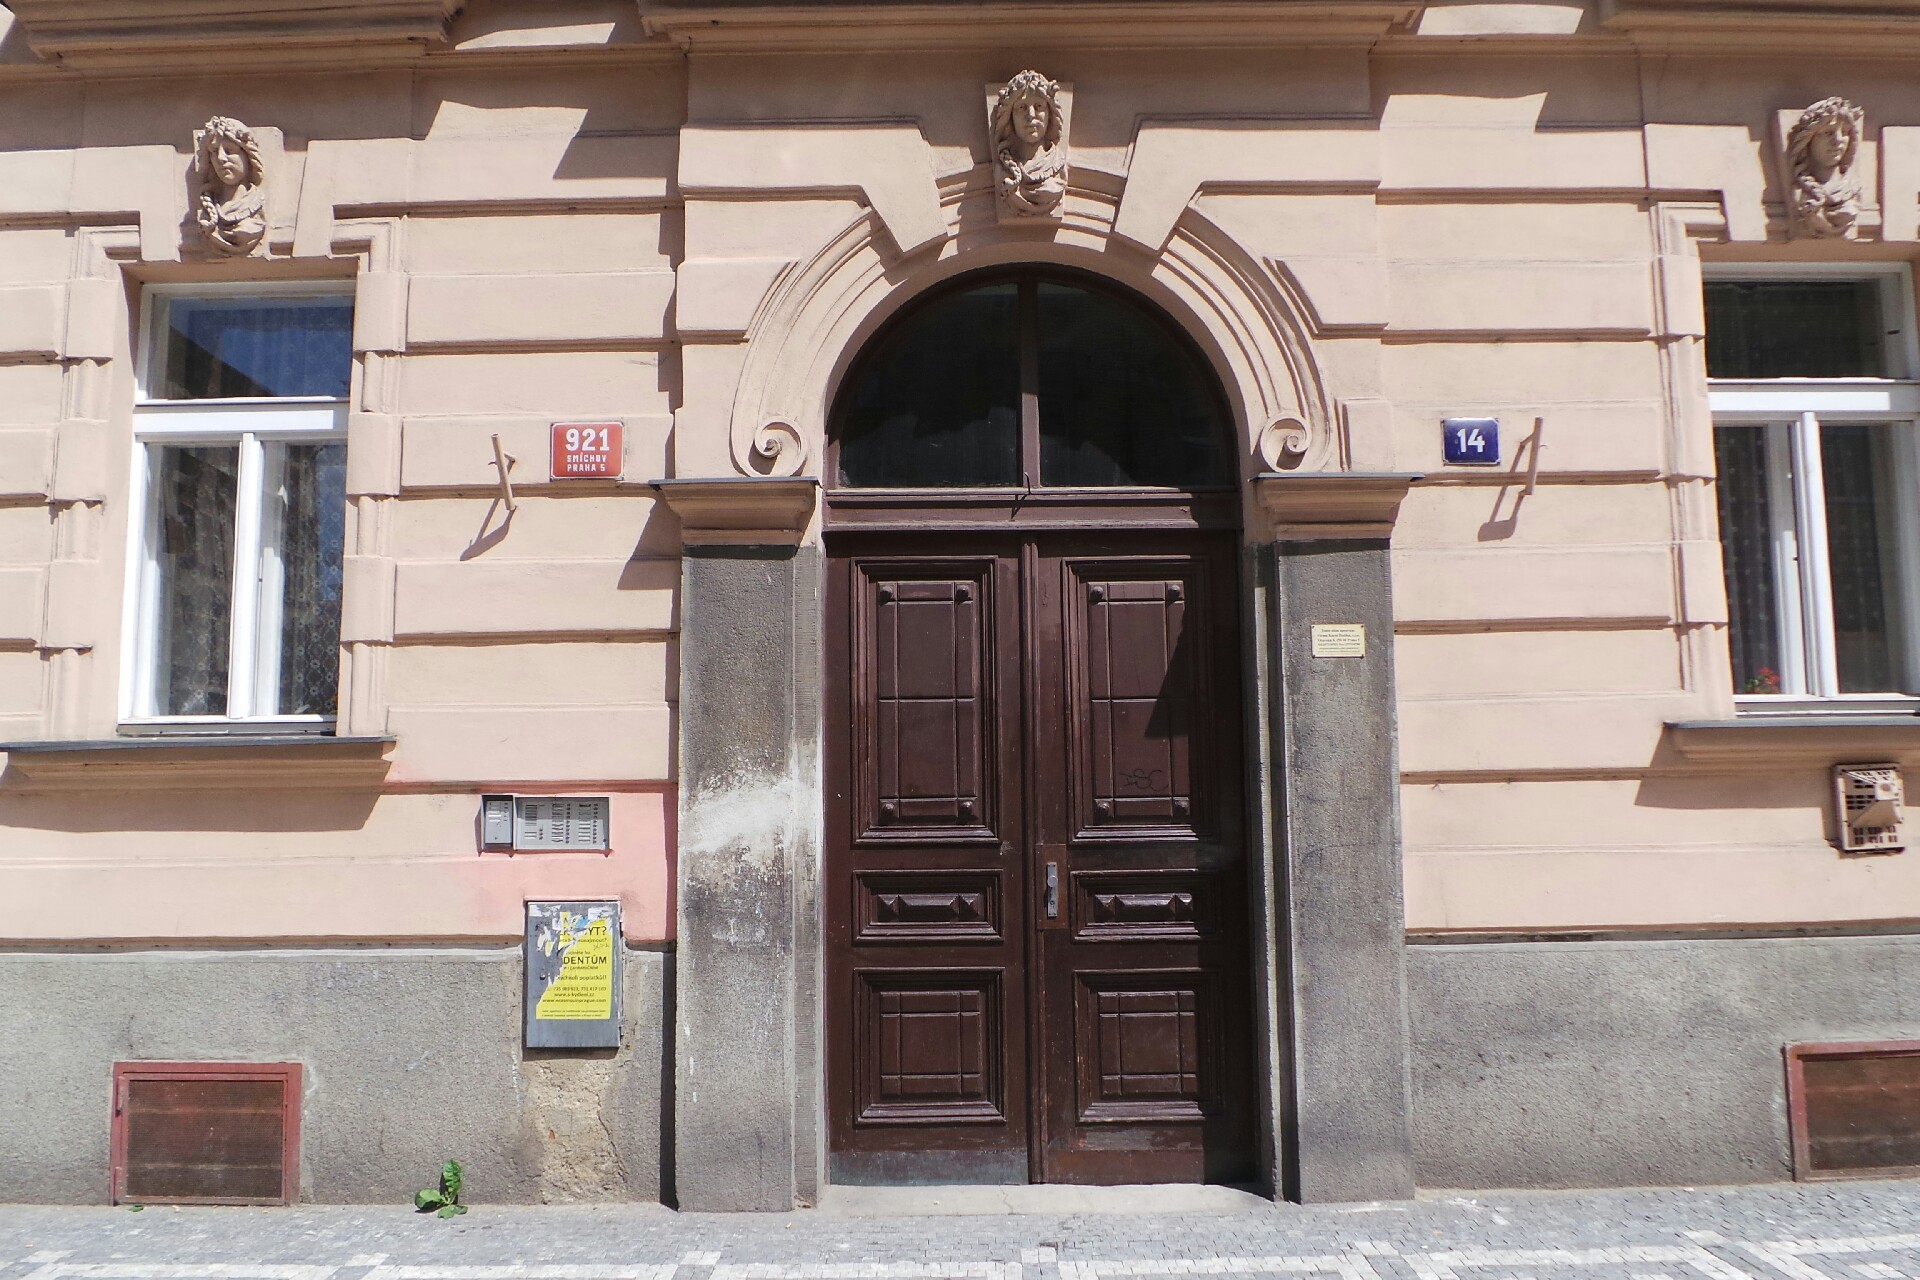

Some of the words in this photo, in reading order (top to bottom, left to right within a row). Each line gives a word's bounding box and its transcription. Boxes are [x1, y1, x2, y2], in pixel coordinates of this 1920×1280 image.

[565, 428, 610, 451] 921
[1457, 428, 1486, 453] 14
[567, 452, 606, 462] SMÍCHOV
[567, 463, 597, 472] PRAHA
[600, 463, 606, 472] 5
[584, 926, 607, 936] YT?
